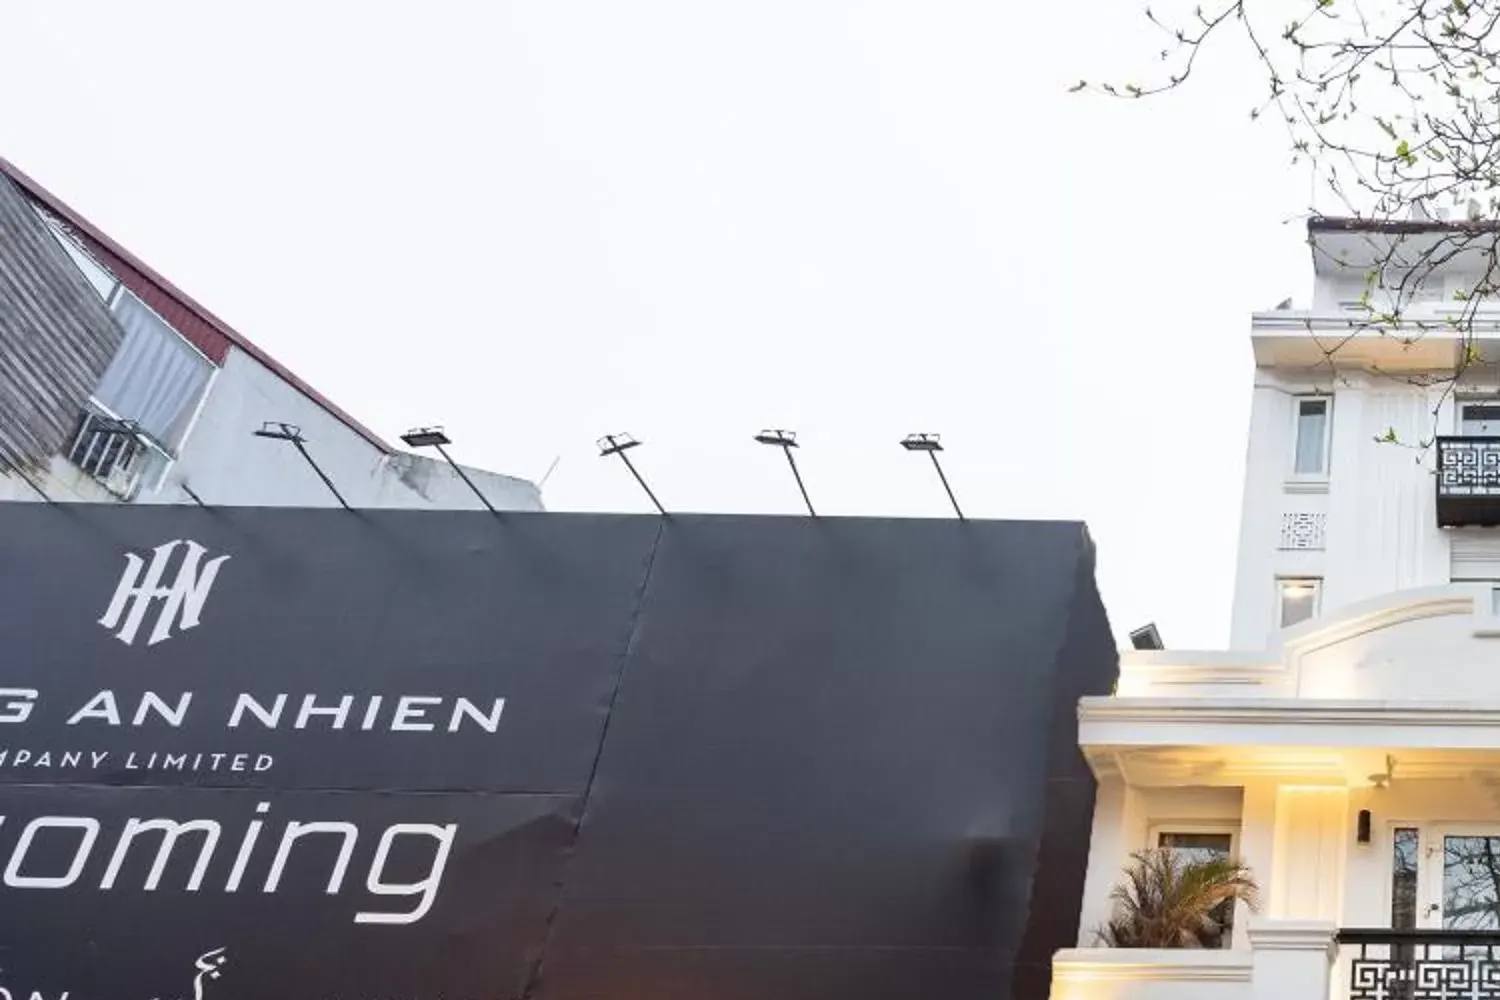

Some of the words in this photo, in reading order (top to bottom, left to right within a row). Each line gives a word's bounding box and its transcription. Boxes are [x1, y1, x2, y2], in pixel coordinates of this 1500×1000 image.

[66, 690, 193, 727] AN
[227, 693, 505, 733] NHIEN
[125, 752, 274, 772] LIMITED
[0, 802, 458, 925] oming
